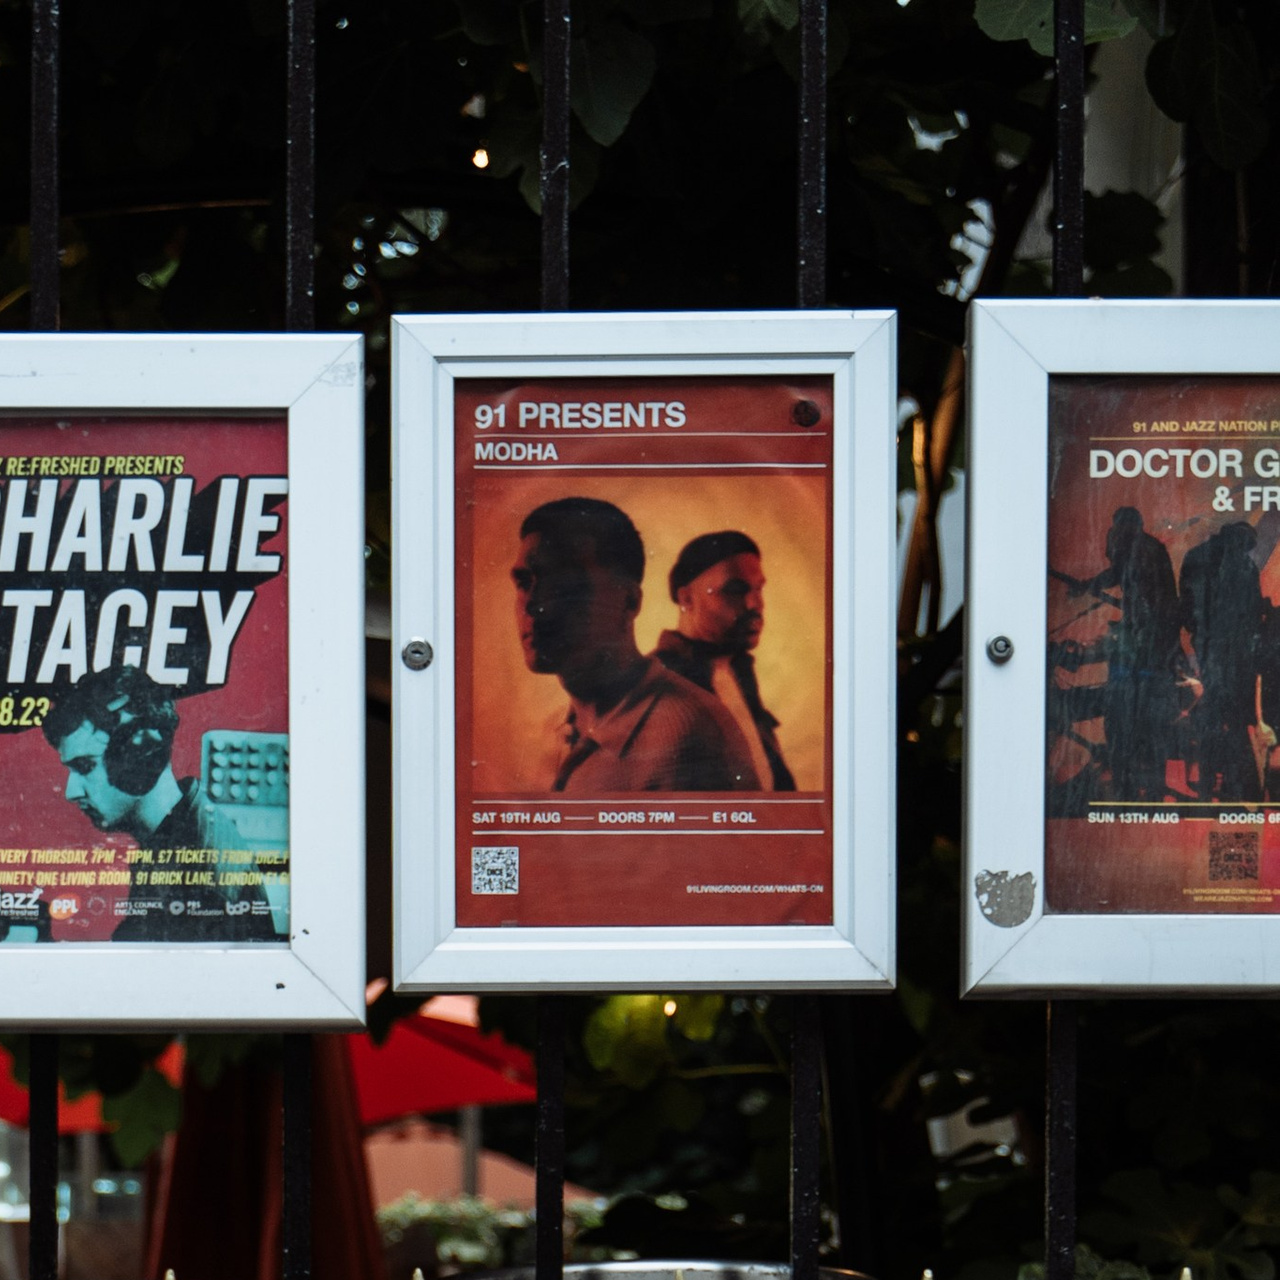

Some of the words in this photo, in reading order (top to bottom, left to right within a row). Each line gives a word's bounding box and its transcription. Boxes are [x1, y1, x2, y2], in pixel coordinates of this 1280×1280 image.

[474, 403, 506, 429] 91
[519, 402, 686, 428] PRESENTS
[1133, 421, 1147, 433] 91
[1151, 421, 1180, 432] AND
[1182, 421, 1216, 432] JAZZ
[1219, 421, 1268, 432] NATION
[474, 442, 558, 461] MODHA
[6, 456, 100, 475] RE:FRESHED
[104, 455, 184, 475] PRESENTS
[1089, 448, 1243, 478] DOCTOR
[1212, 486, 1235, 512] &
[472, 812, 497, 824] SAT
[500, 812, 531, 824] 19TH
[533, 812, 561, 824] AUG
[599, 812, 645, 823] DOORS
[649, 812, 675, 823] 7PM
[713, 811, 728, 823] E1
[731, 811, 756, 824] 6QL
[1088, 812, 1115, 824] SUN
[1119, 812, 1149, 824] 13TH
[1152, 812, 1180, 824] AUG
[1219, 812, 1265, 824] DOORS
[31, 849, 89, 865] THURSDAY,
[91, 849, 116, 863] 7PM
[124, 849, 155, 865] 11PM,
[158, 849, 174, 863] £7
[175, 847, 219, 864] TICKETS
[221, 849, 254, 864] FROM
[36, 871, 57, 886] ONE
[60, 871, 96, 886] LIVING
[99, 871, 132, 887] ROOM,
[136, 872, 148, 885] 91
[150, 871, 182, 885] BRICK
[185, 871, 216, 887] LANE,
[219, 871, 263, 886] LONDON
[52, 898, 79, 914] PPL
